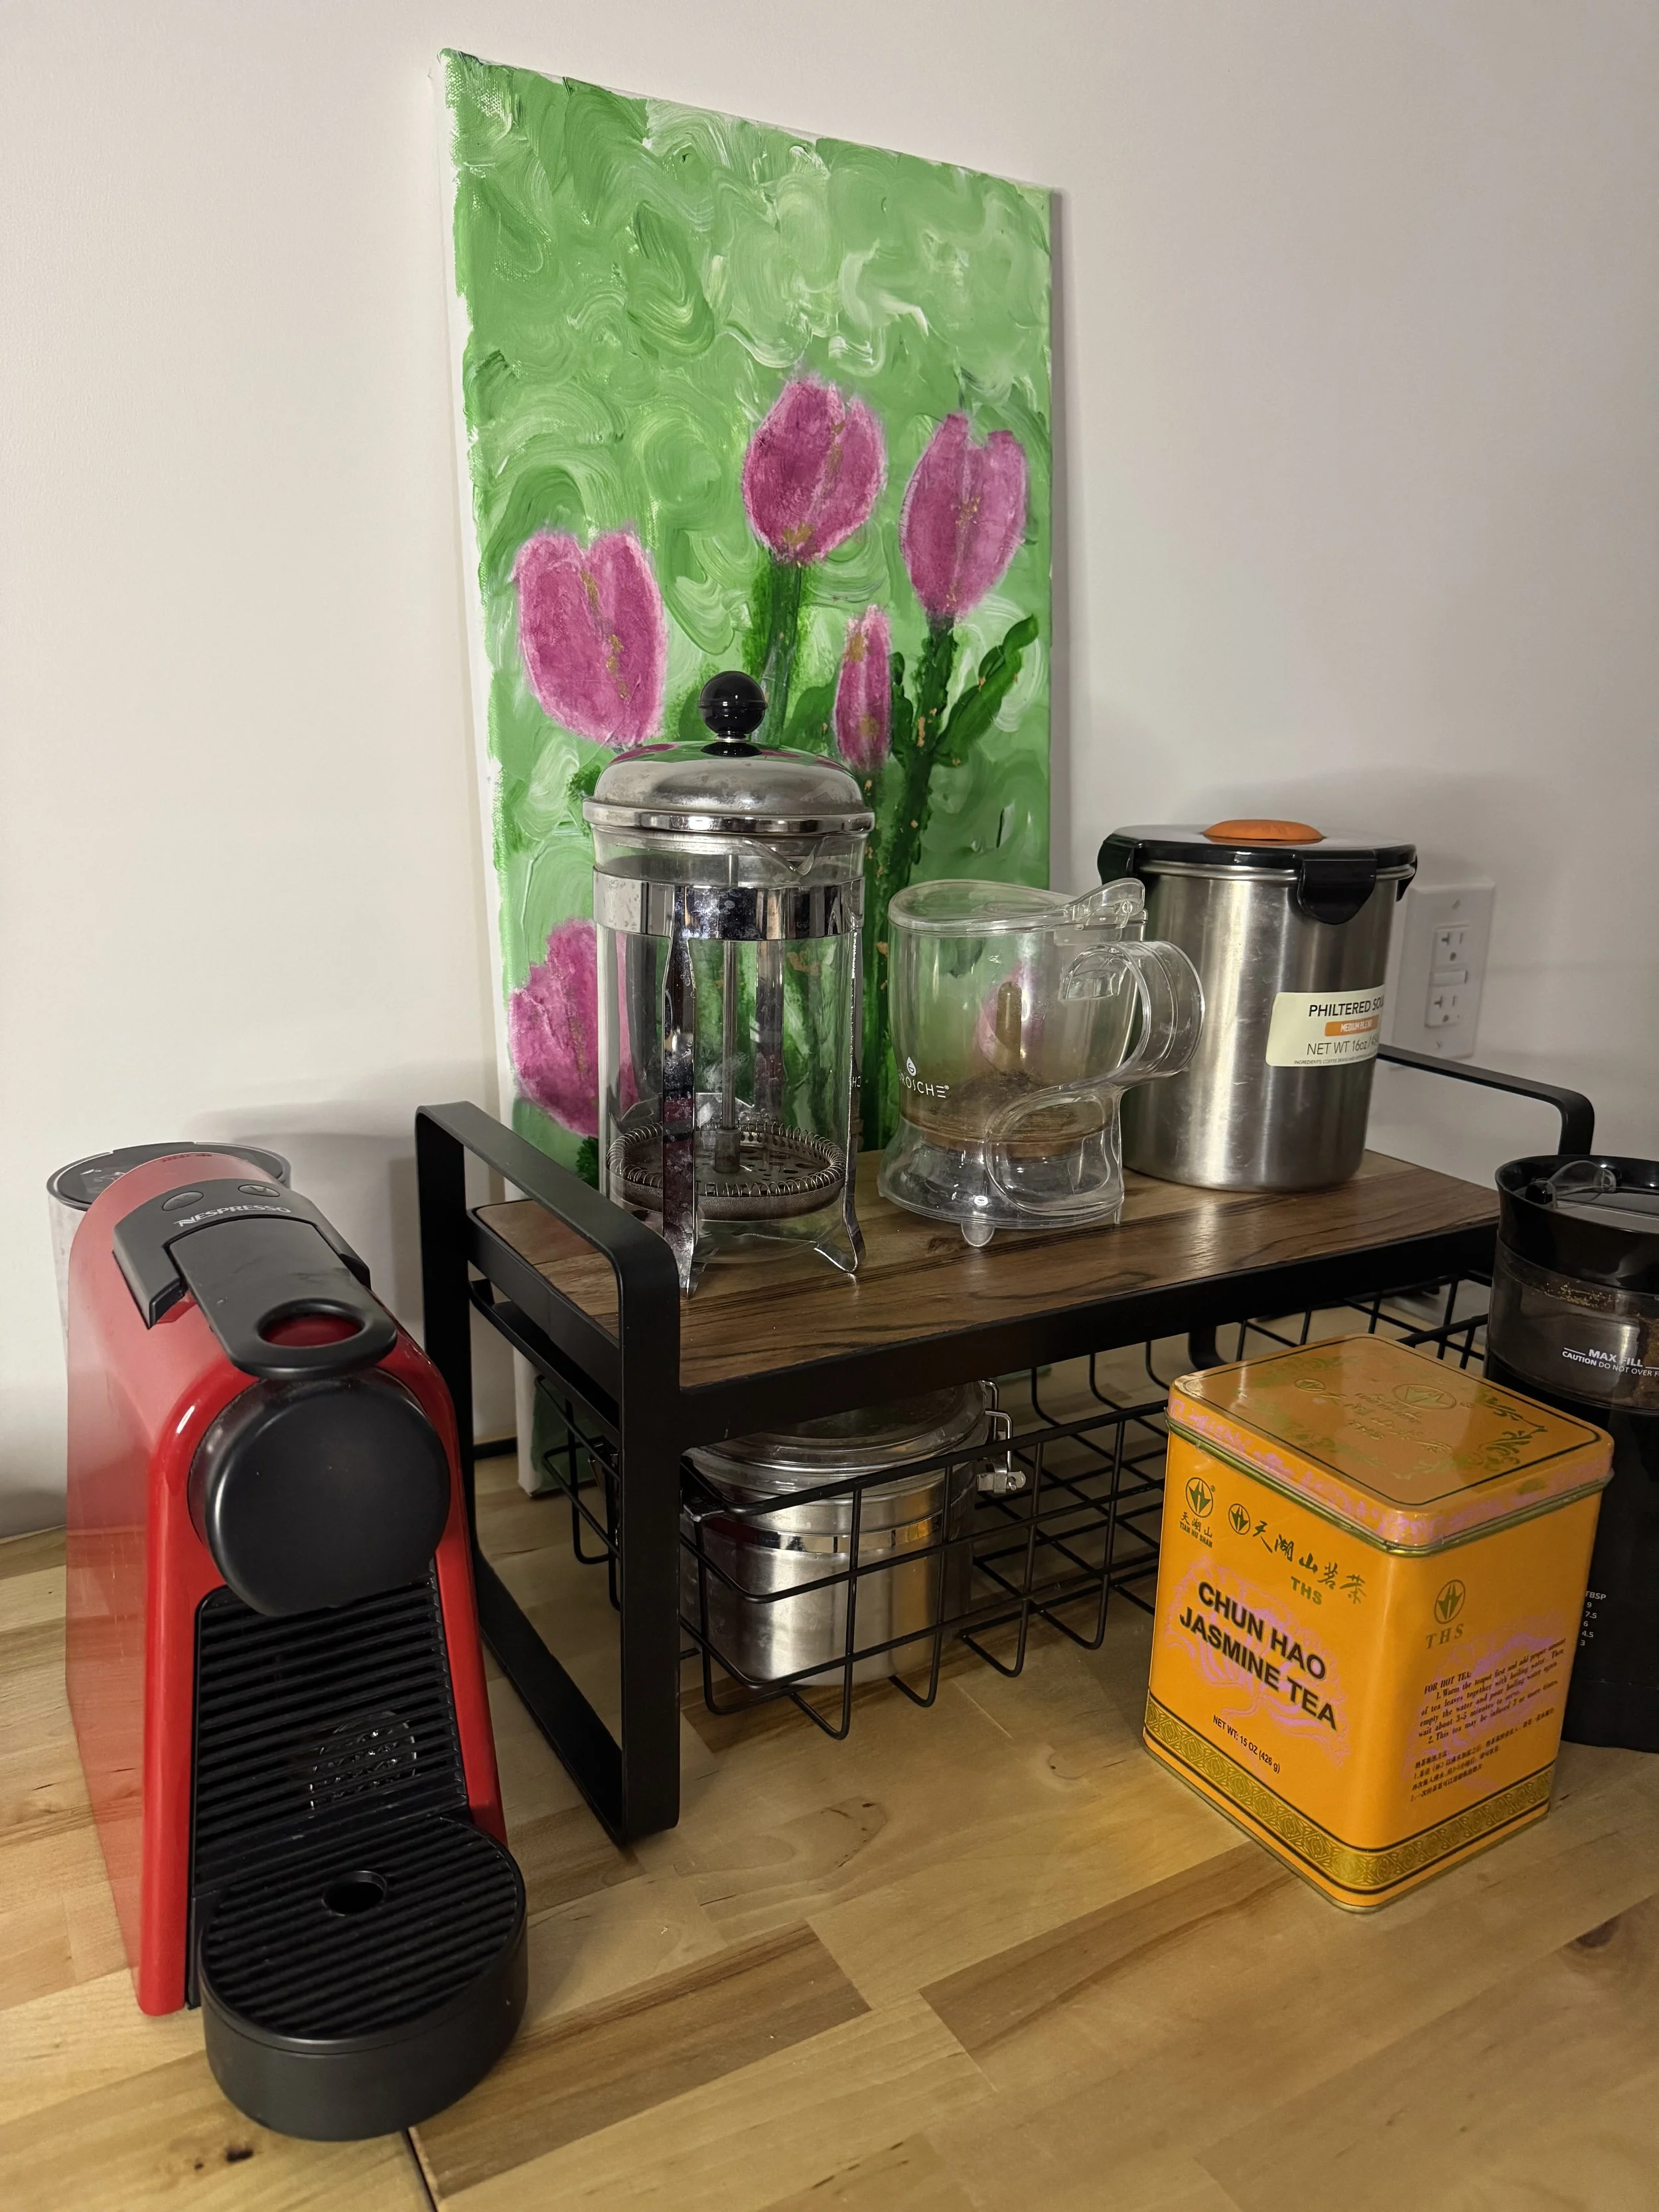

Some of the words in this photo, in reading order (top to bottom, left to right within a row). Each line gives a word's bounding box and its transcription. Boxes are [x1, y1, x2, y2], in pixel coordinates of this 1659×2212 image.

[1309, 1000, 1370, 1017] PHILTERED
[1307, 1042, 1331, 1055] NET
[1333, 1040, 1350, 1054] WT
[897, 1070, 946, 1098] ROSCHE
[173, 1205, 292, 1227] NESPRESSO
[1562, 1351, 1597, 1366] CAUTION
[1613, 1364, 1630, 1373] NOT
[1631, 1368, 1652, 1376] OVER
[1589, 1349, 1617, 1363] MAX
[1620, 1357, 1643, 1367] FILL
[1180, 1520, 1190, 1534] TIAN
[1192, 1529, 1198, 1539] HU
[1200, 1534, 1212, 1548] SHAN
[1291, 1576, 1322, 1605] THS
[1585, 1591, 1607, 1600] TBSP
[1198, 1581, 1264, 1643] CHUN
[1271, 1627, 1326, 1680] HAO
[1179, 1606, 1280, 1692] JASMINE
[1287, 1676, 1336, 1731] TEA
[1424, 1682, 1438, 1694] FOR
[1441, 1676, 1455, 1688] HOT
[1462, 1681, 1472, 1690] the
[1419, 1714, 1439, 1727] empty
[1442, 1709, 1453, 1718] the
[1456, 1701, 1474, 1712] water
[1475, 1693, 1487, 1704] and
[1431, 1704, 1441, 1713] tea
[1435, 1718, 1453, 1731] about
[1213, 1715, 1226, 1730] NET
[1227, 1724, 1238, 1740] WT:
[1240, 1735, 1248, 1747] 15
[1248, 1741, 1258, 1755] OZ
[1259, 1750, 1272, 1766] (426
[1273, 1763, 1280, 1774] g)
[1436, 1730, 1449, 1740] This
